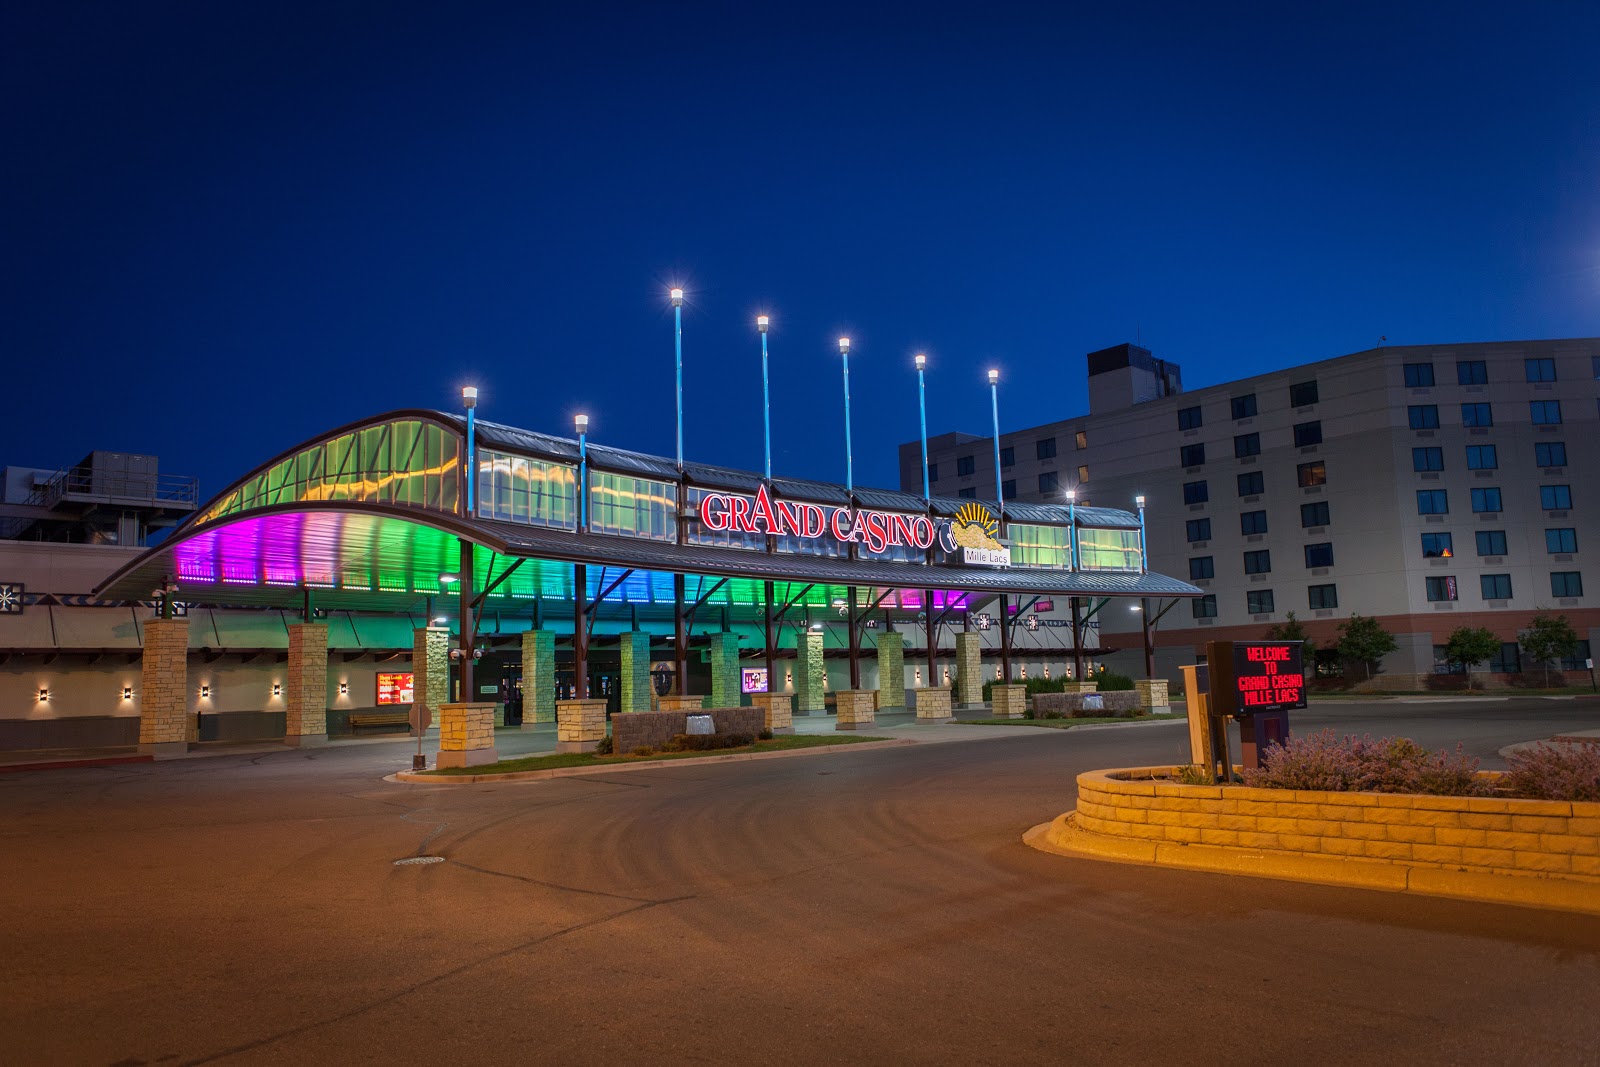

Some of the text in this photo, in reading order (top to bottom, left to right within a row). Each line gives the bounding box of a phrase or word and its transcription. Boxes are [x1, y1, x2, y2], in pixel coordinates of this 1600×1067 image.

[701, 484, 933, 553] GRAND CASINO
[966, 550, 1008, 564] Mille Lacs
[1247, 646, 1290, 661] WELCOME
[1264, 661, 1277, 675] TO
[1238, 674, 1303, 691] GRAND CASINO
[1244, 689, 1299, 705] MILLE LACS
